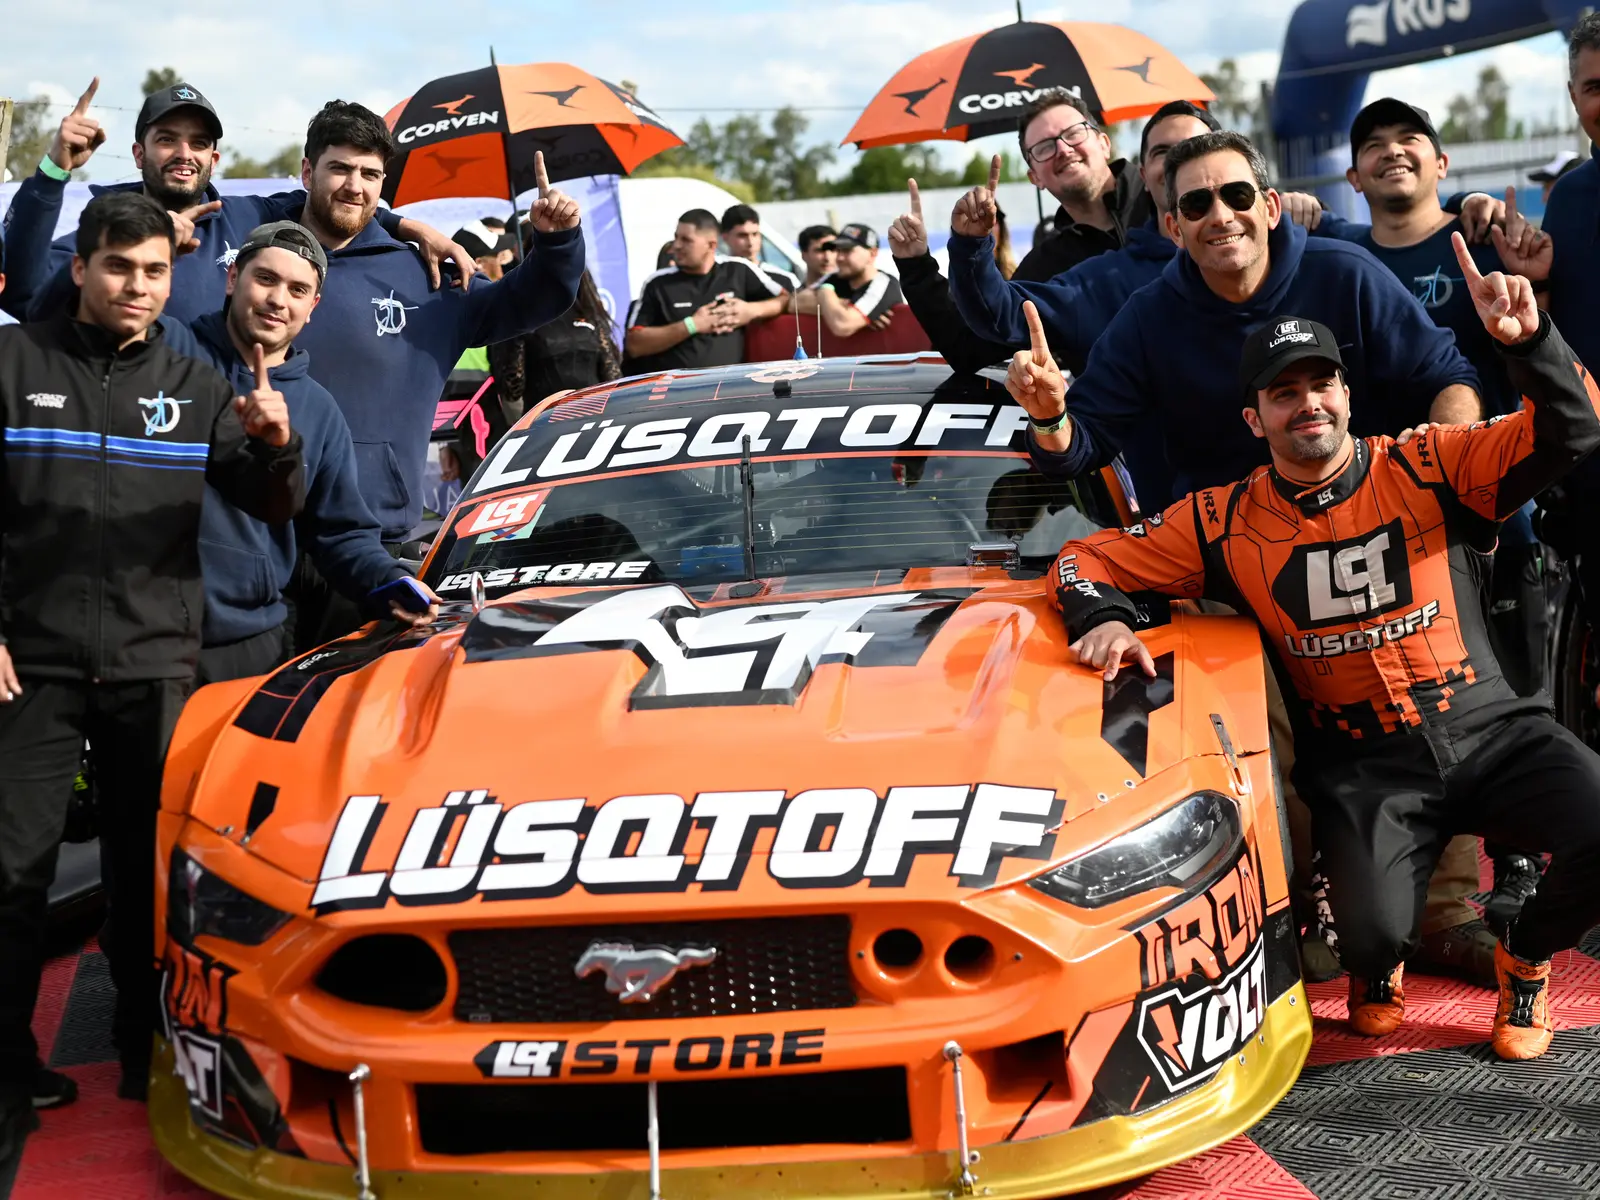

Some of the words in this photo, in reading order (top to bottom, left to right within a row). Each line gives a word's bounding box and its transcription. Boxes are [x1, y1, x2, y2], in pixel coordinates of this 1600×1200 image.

[397, 110, 499, 143] CORVEN
[1202, 491, 1220, 525] HRX
[483, 561, 651, 588] STORE
[1284, 600, 1440, 658] LÜSQTOFF
[311, 783, 1058, 907] LÜSQTOFF
[1145, 838, 1264, 988] IRON
[1150, 948, 1265, 1079] VOLT
[569, 1027, 826, 1076] STORE
